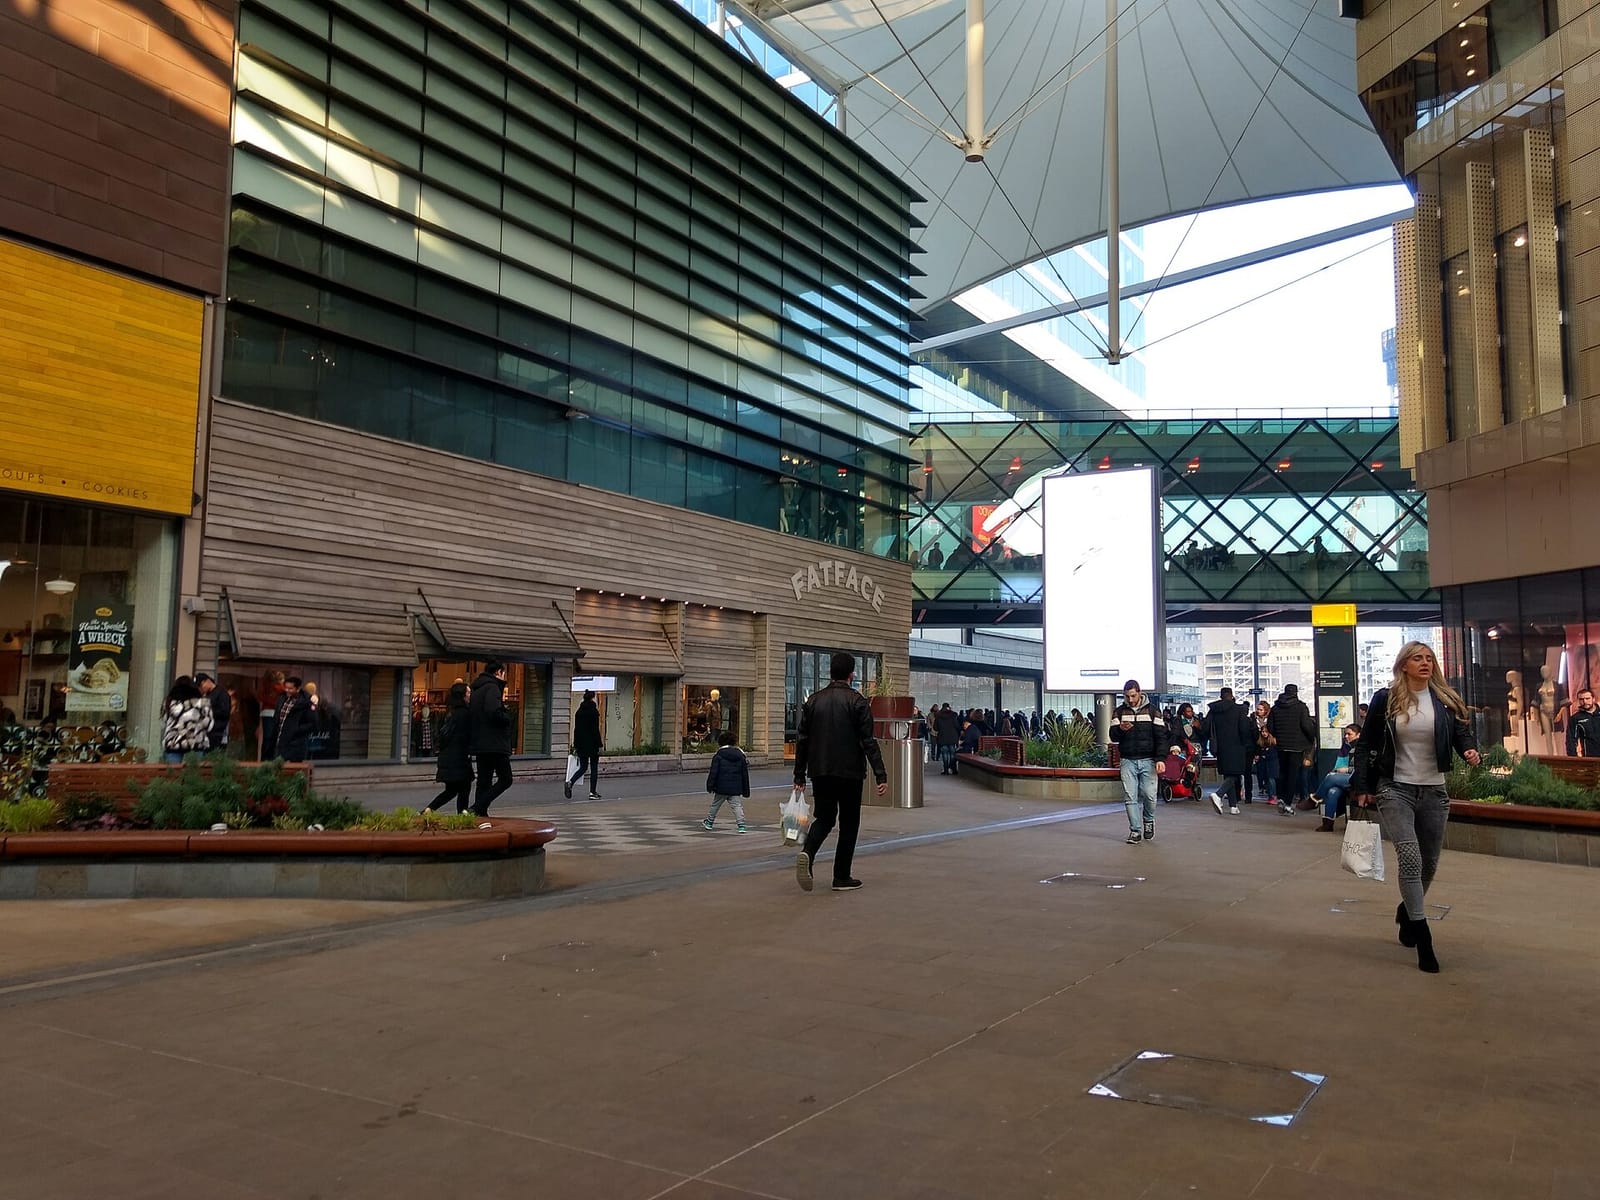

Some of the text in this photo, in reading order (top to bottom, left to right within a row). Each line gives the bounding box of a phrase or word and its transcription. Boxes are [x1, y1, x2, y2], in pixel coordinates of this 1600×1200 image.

[82, 481, 149, 500] COOKIES
[790, 560, 885, 615] FATFACE
[78, 631, 127, 647] A WRECK
